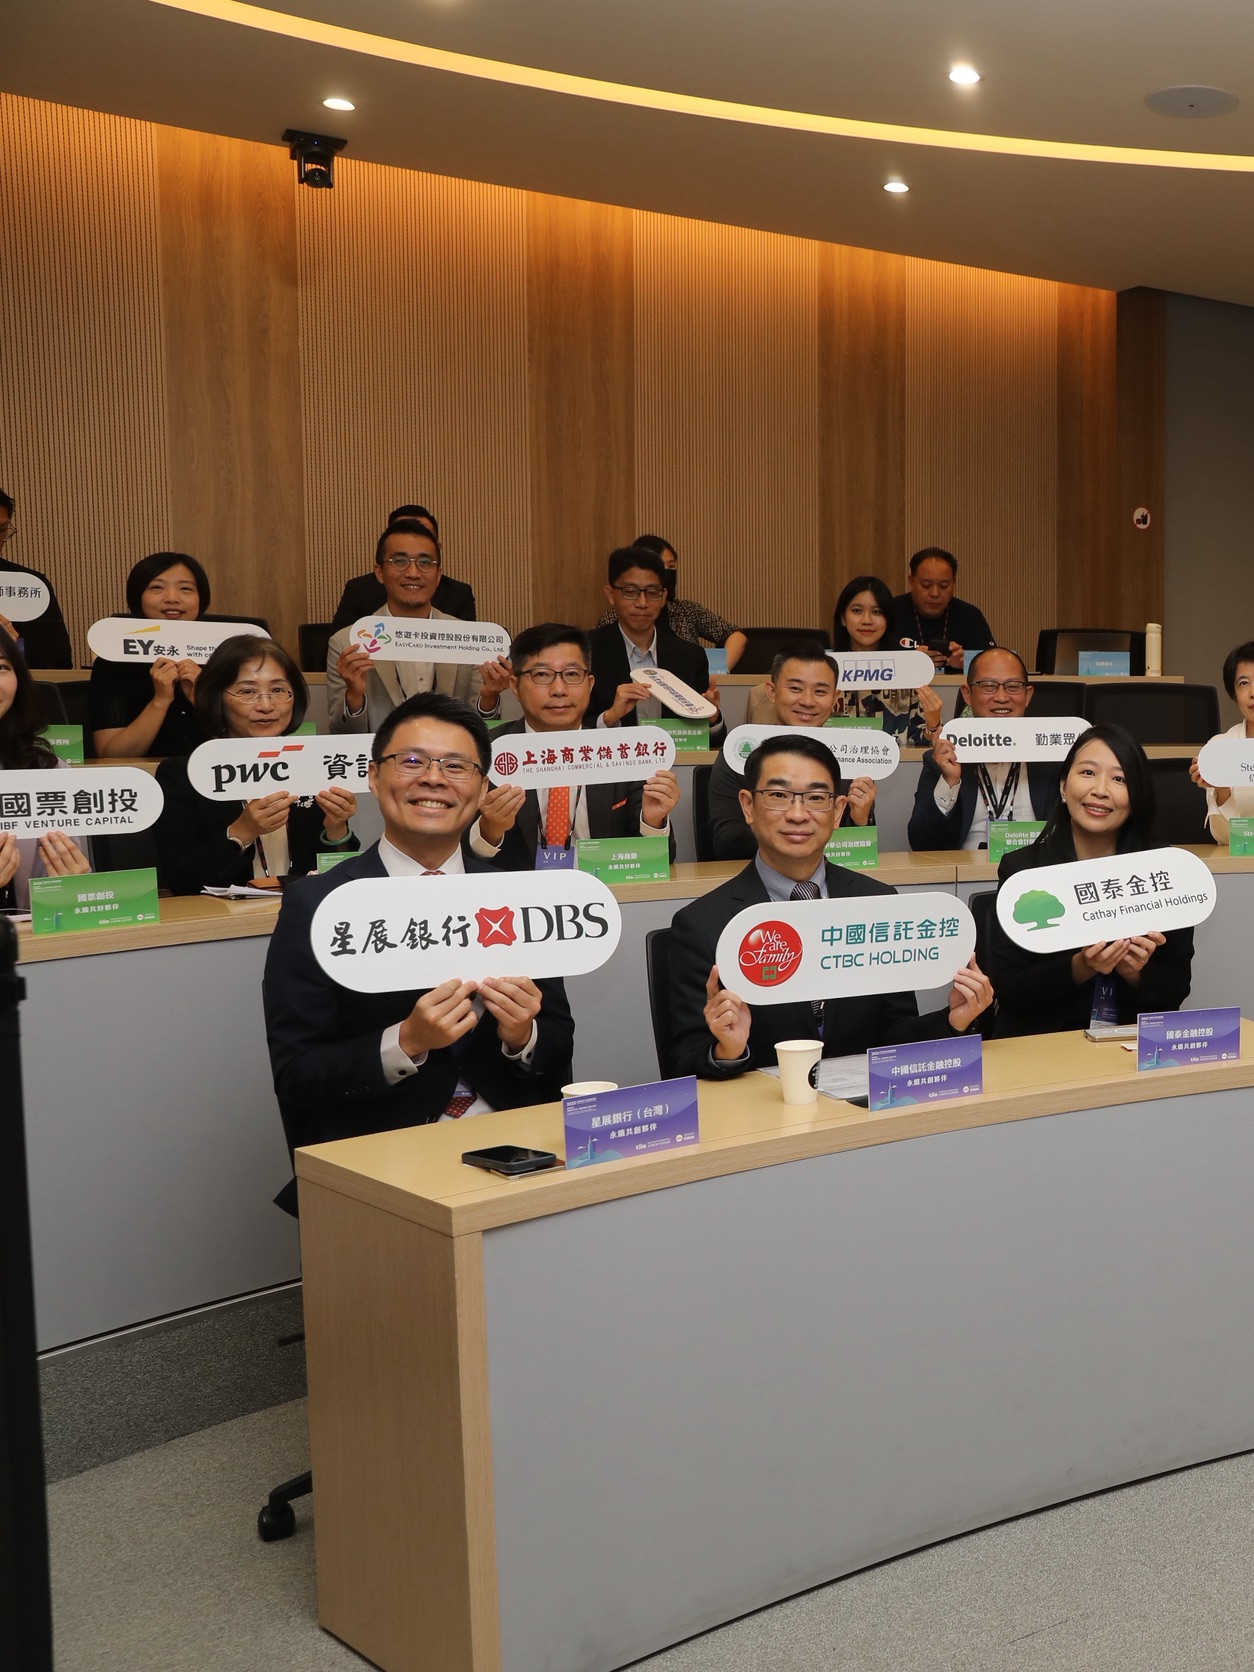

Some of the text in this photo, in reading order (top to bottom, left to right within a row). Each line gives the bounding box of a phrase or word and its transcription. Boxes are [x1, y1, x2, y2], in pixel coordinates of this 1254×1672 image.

[394, 630, 504, 644] 悠遊卡投資控股股份有限公司
[153, 645, 180, 656] 安永
[186, 644, 207, 652] Shape
[842, 668, 893, 682] KPMG
[1035, 733, 1082, 746] 勤業眾
[522, 741, 668, 766] 上海商業儲蓄銀行
[568, 763, 603, 771] COMMERCIAL
[856, 757, 893, 765] Association
[211, 761, 290, 793] pwc
[0, 788, 138, 818] 國票創投
[0, 816, 134, 830] IBF VENTURE CAPITAL
[543, 852, 567, 860] VIP
[1073, 870, 1174, 905] 國泰金控
[1082, 892, 1208, 922] Cathay Financial Holdings
[329, 902, 609, 957] 星展銀行 DBS
[760, 930, 782, 943] We
[821, 917, 960, 947] 中國信託金控
[768, 940, 787, 952] are
[820, 946, 940, 970] CTBC HOLDING
[1166, 1027, 1214, 1040] 國泰金融控股
[891, 1057, 962, 1076] 中國信託金融控股
[609, 1122, 658, 1140] 永續共創夥伴
